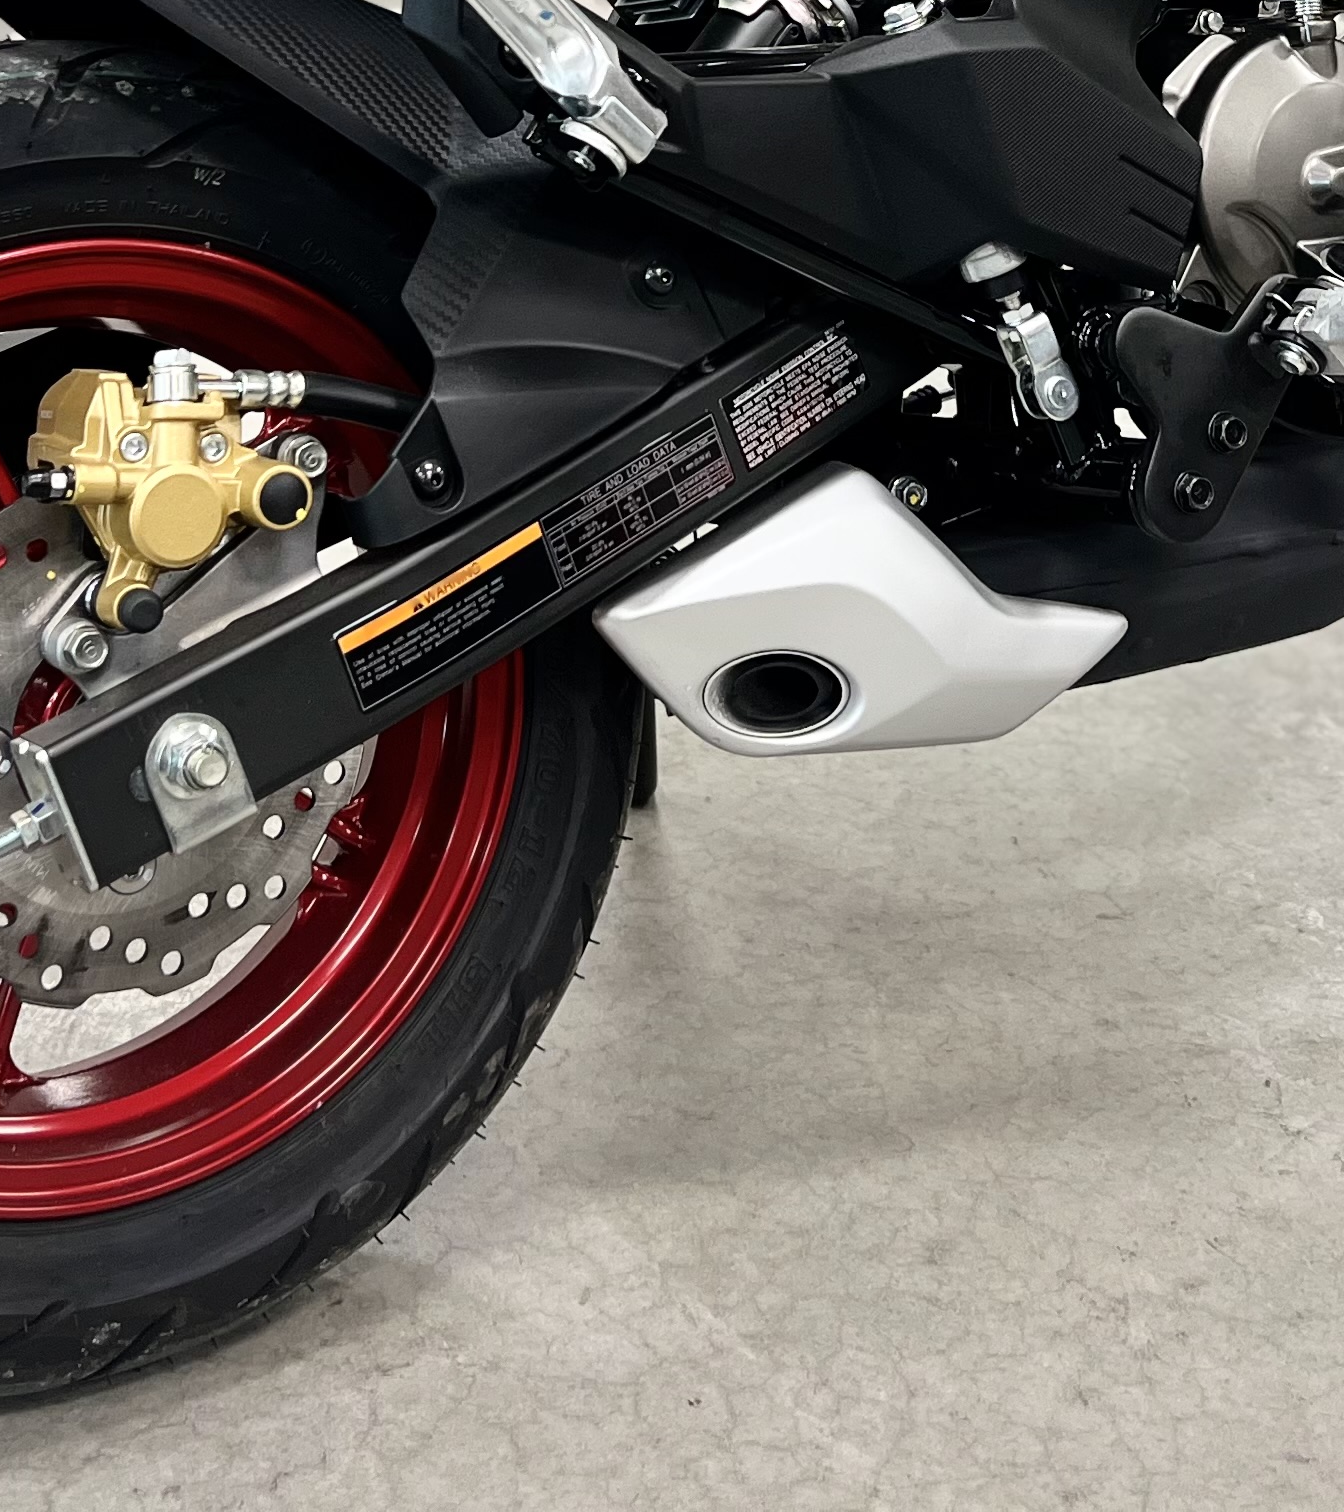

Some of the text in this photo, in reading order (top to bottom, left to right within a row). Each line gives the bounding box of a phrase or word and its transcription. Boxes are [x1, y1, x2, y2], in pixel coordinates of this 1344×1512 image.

[580, 487, 602, 505] TIRE
[606, 474, 623, 491] AND
[626, 457, 650, 478] LOAD
[653, 441, 676, 461] DATA
[424, 562, 482, 603] WARNING
